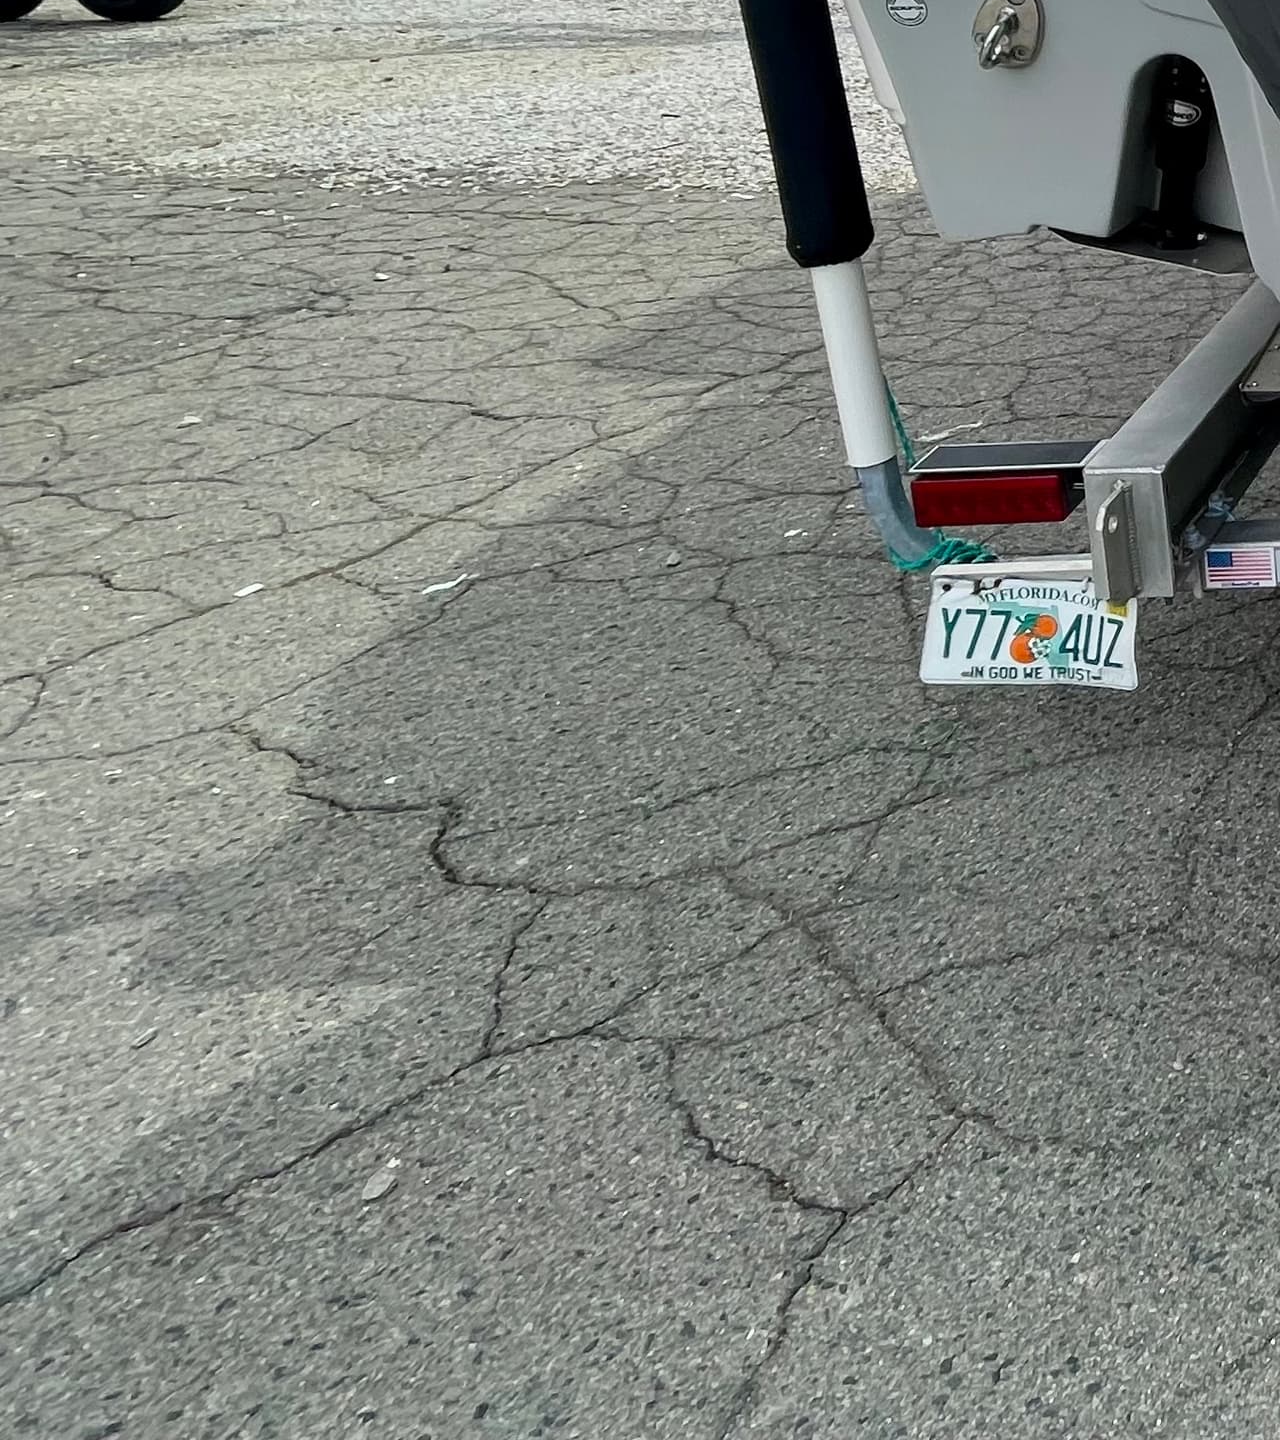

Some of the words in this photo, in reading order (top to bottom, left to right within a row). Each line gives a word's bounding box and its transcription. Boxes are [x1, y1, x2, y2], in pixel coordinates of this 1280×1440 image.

[942, 607, 1013, 660] Y77
[1059, 613, 1125, 668] 4UZ
[969, 666, 984, 679] IN
[988, 666, 1018, 680] GOD
[1023, 666, 1042, 680] WE
[1050, 666, 1091, 682] TRUST
